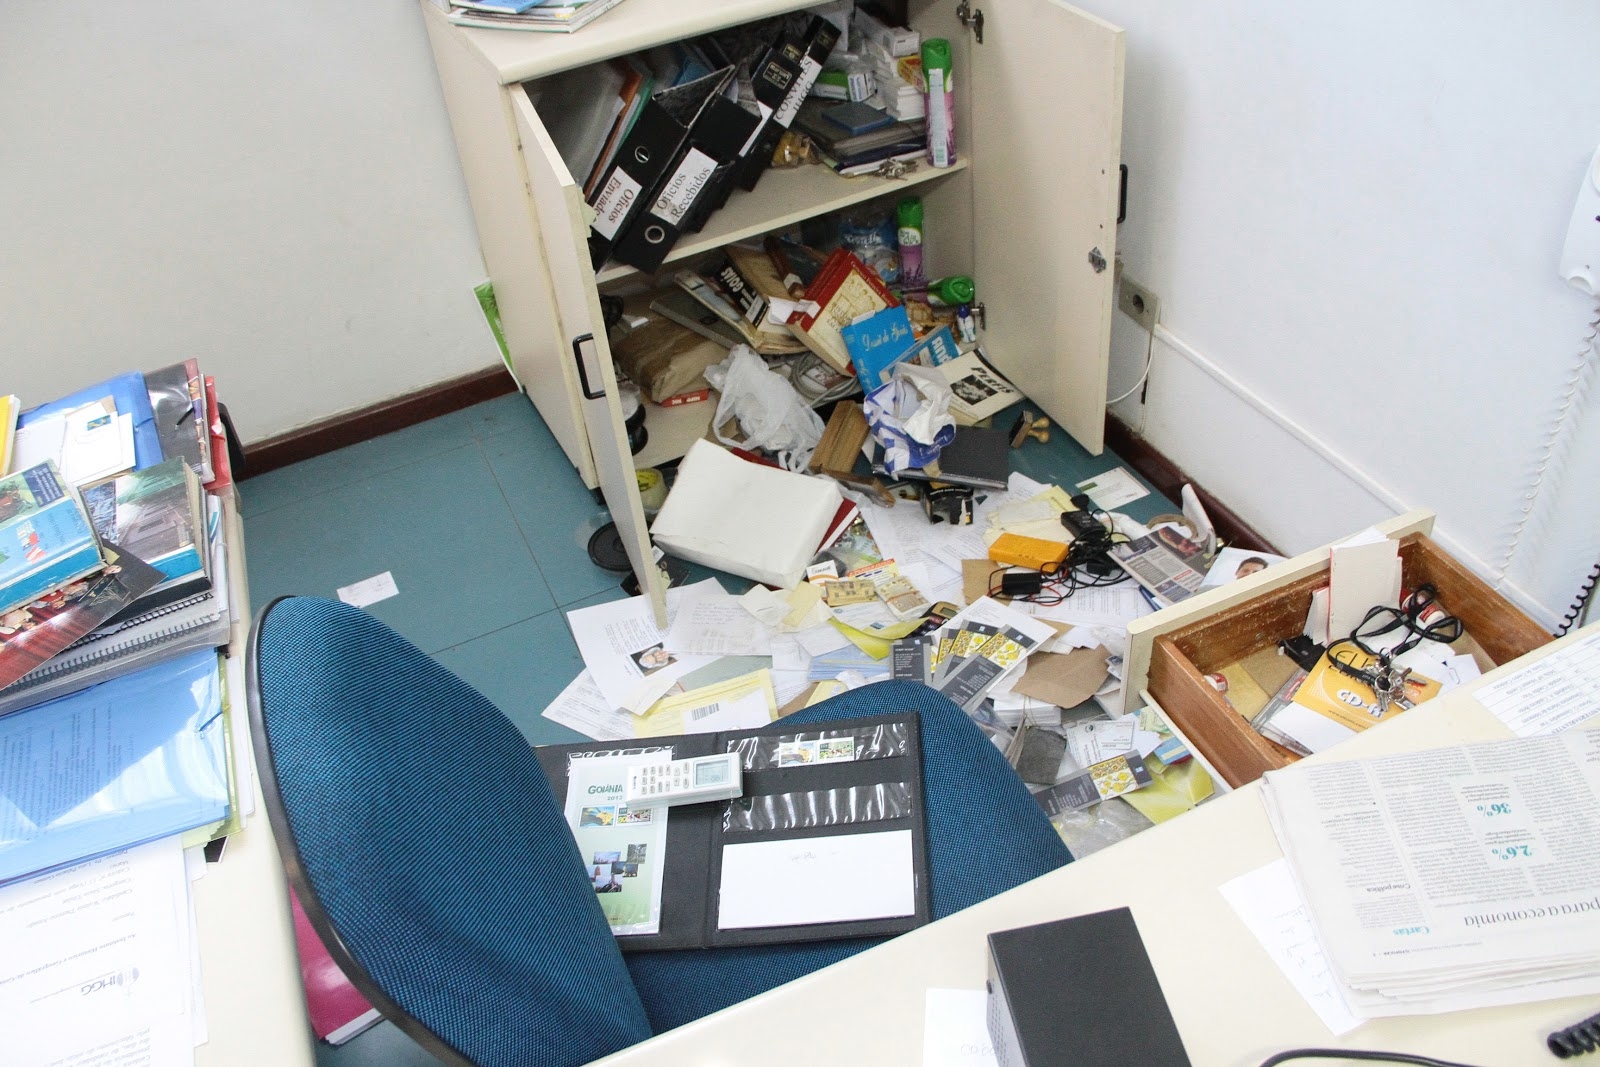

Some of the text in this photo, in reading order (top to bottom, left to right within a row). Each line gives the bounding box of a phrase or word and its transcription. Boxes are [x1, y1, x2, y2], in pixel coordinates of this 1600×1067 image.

[776, 59, 812, 120] CONVITES
[671, 167, 711, 219] Recebidos
[1477, 802, 1512, 817] 36%
[1464, 896, 1600, 928] para a economia
[1392, 926, 1430, 936] Cartas
[81, 975, 116, 996] IHGG
